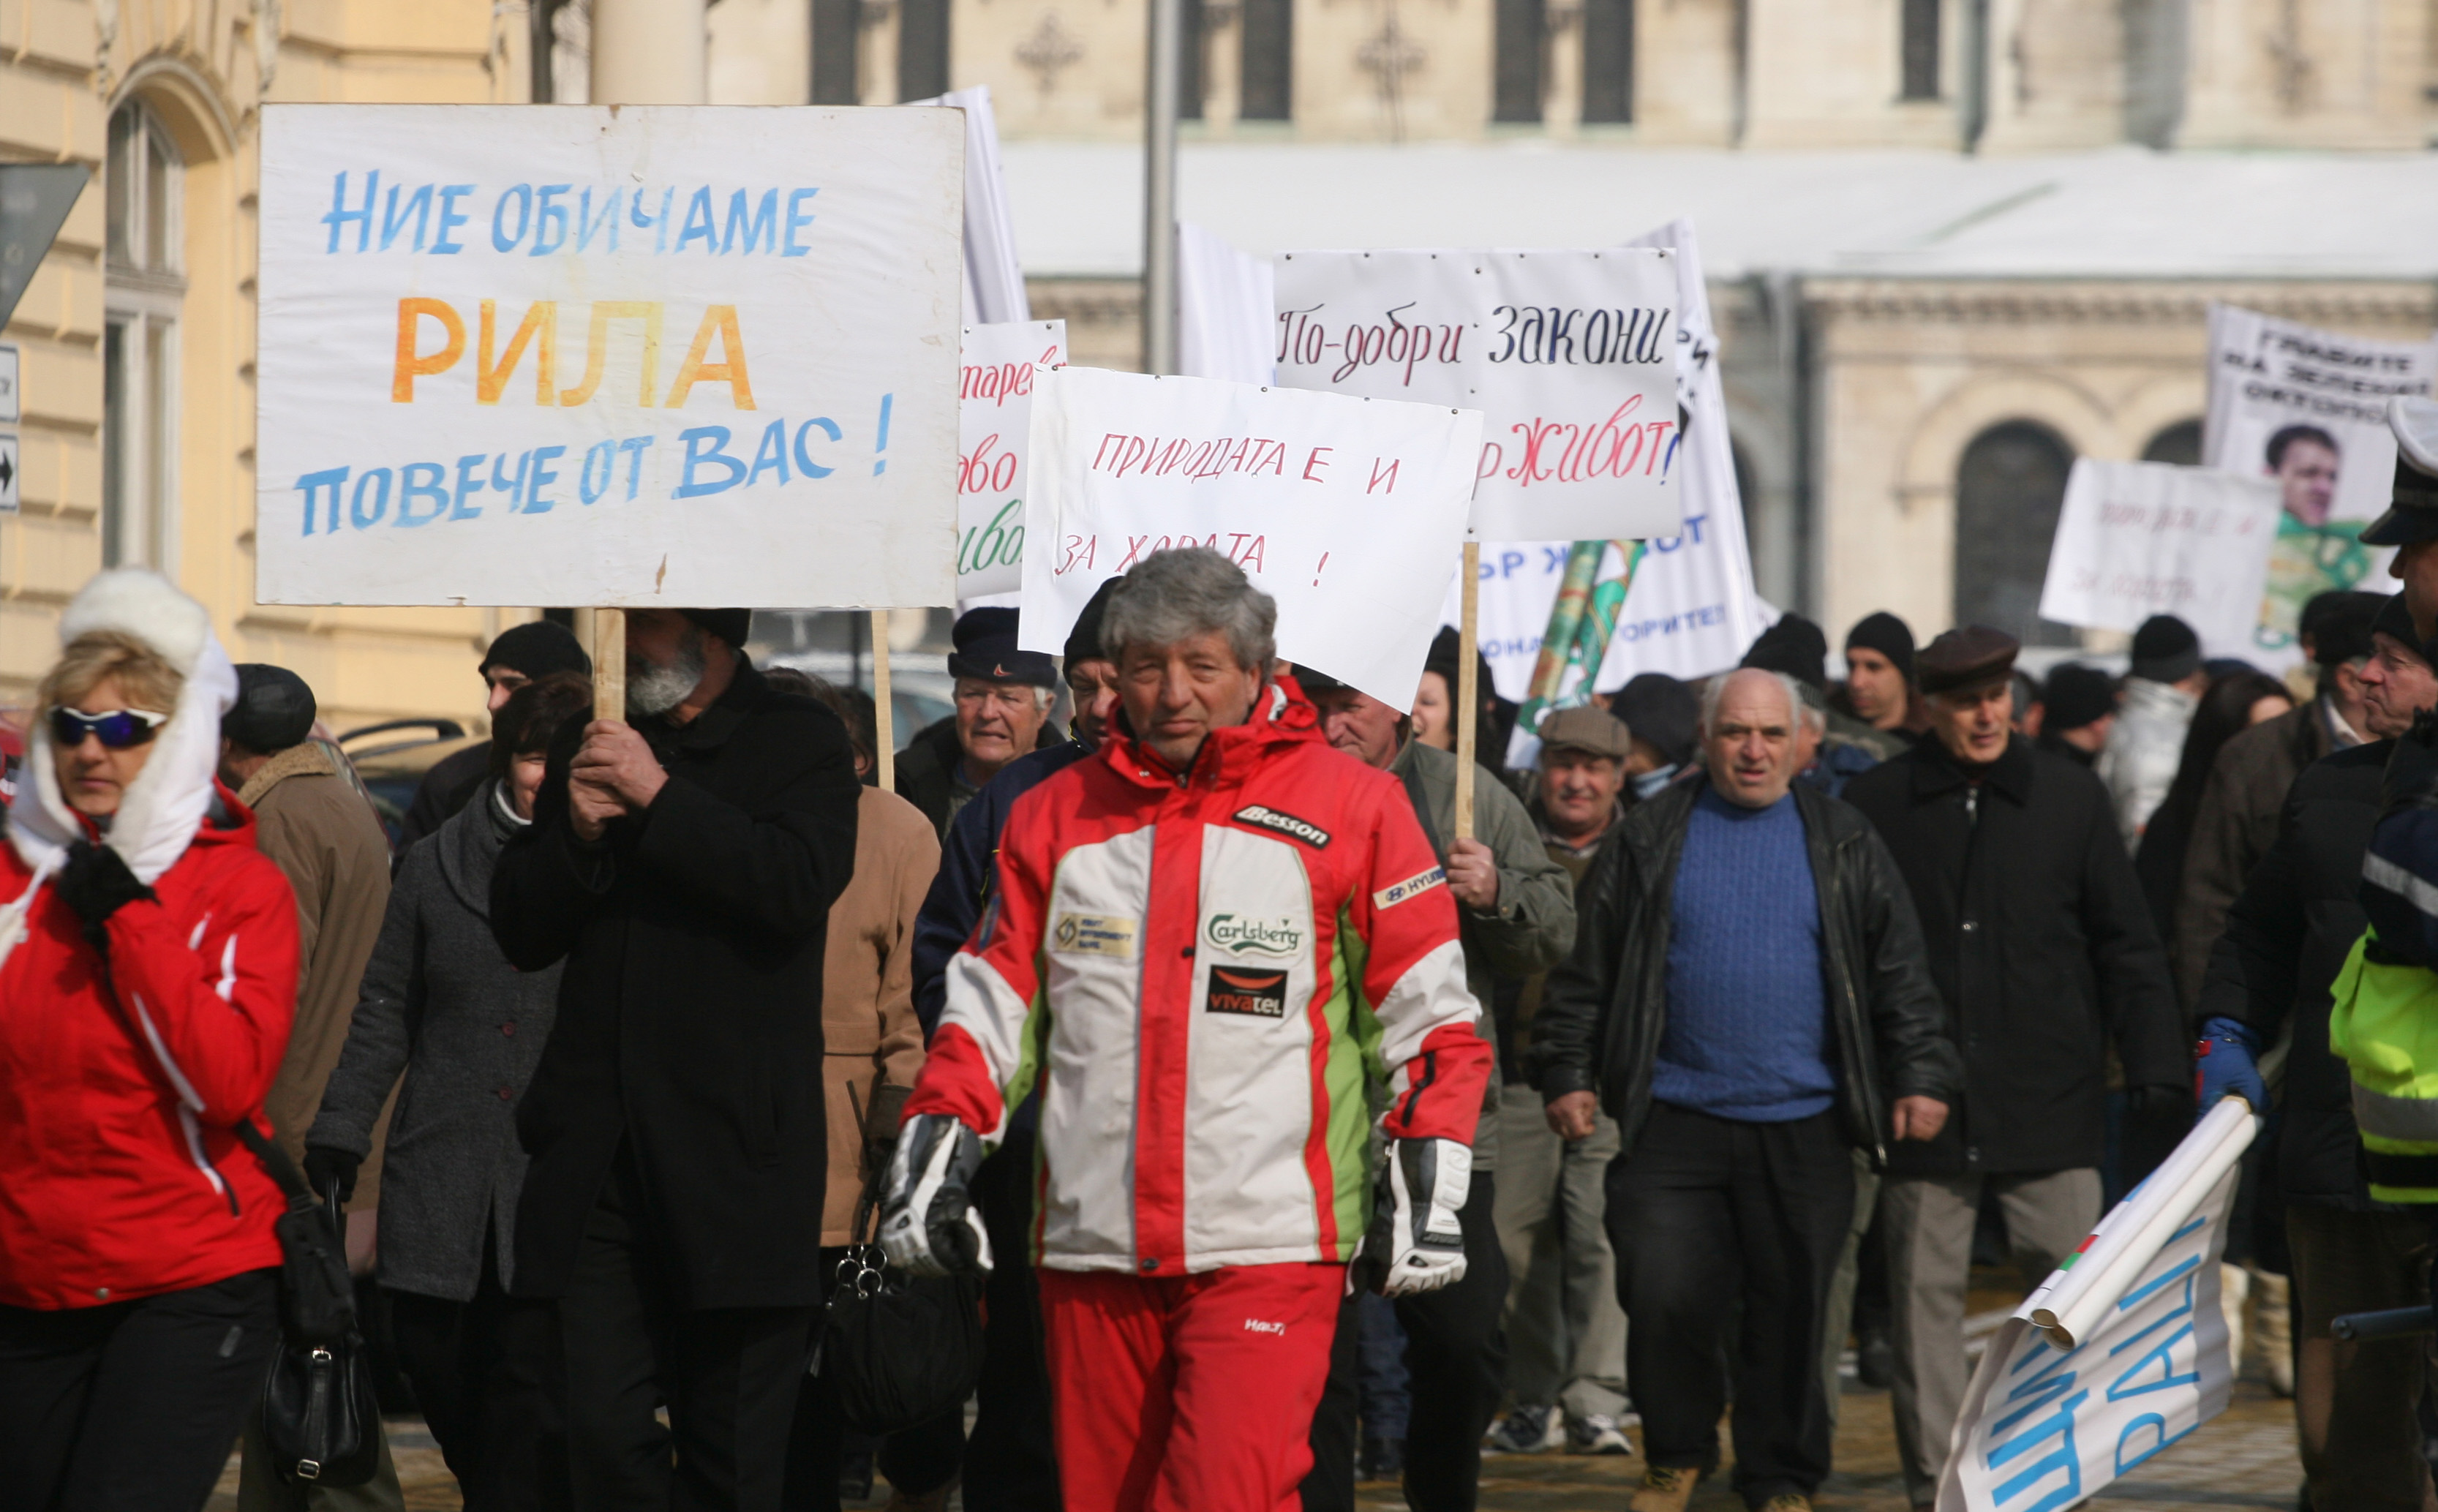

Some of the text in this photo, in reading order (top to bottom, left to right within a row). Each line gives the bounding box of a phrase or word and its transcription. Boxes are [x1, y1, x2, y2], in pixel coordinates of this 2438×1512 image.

[320, 170, 820, 257] НИЕ ОБИЧАМЕ
[391, 296, 757, 411] РИЛА
[1277, 302, 1463, 386] По-добри
[294, 445, 568, 537] ПОВЕЧЕ
[579, 435, 655, 506] ОТ
[671, 416, 843, 500] ВАС
[1093, 433, 1400, 494] ПРИРОДАТА Е И
[1055, 535, 1096, 575] ЗА
[1236, 805, 1329, 846] Besson
[1208, 914, 1303, 952] Carlsberg
